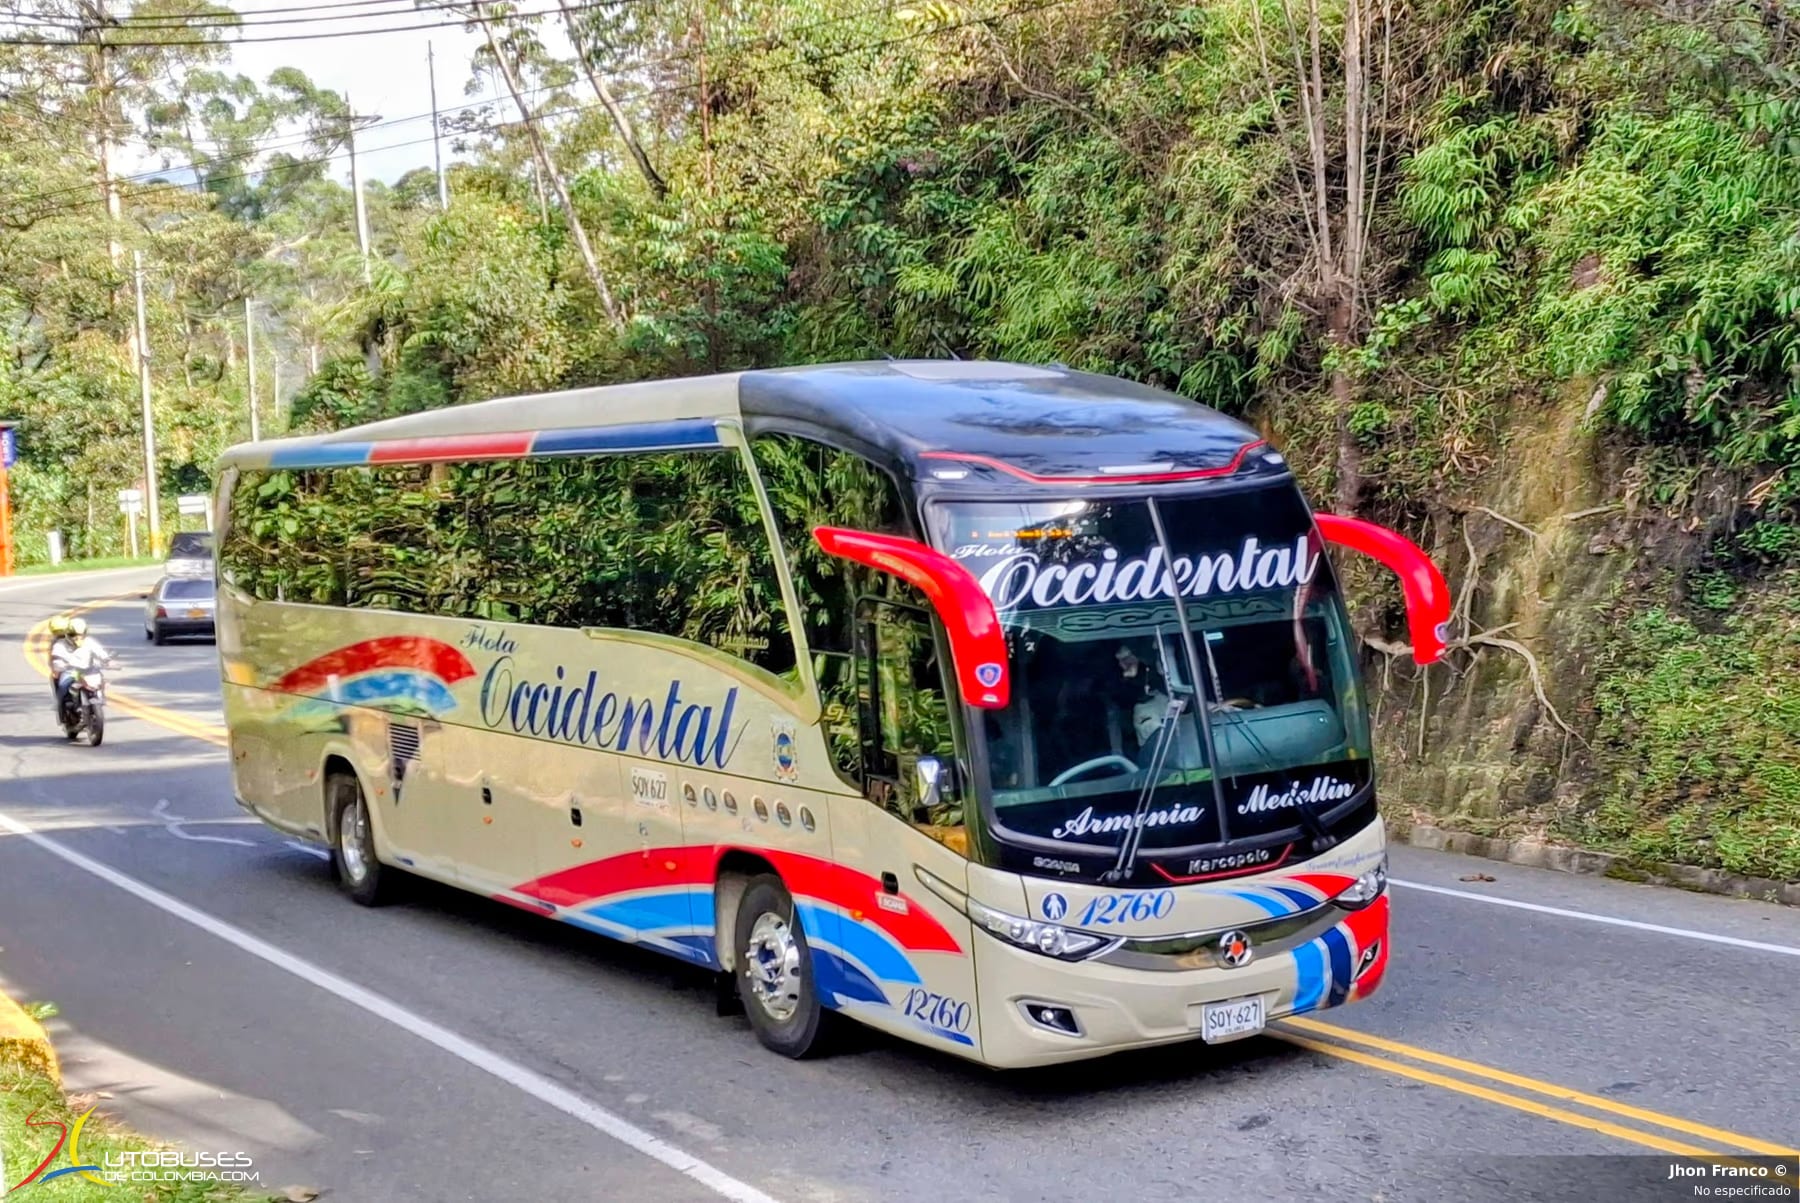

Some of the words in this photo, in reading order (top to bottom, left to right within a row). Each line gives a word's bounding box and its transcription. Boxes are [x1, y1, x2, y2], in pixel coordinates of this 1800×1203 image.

[979, 535, 1320, 611] Occidental
[480, 656, 750, 769] Occidental
[1188, 849, 1269, 874] Marcopolo
[1074, 890, 1176, 926] 12760
[900, 988, 971, 1032] 12760
